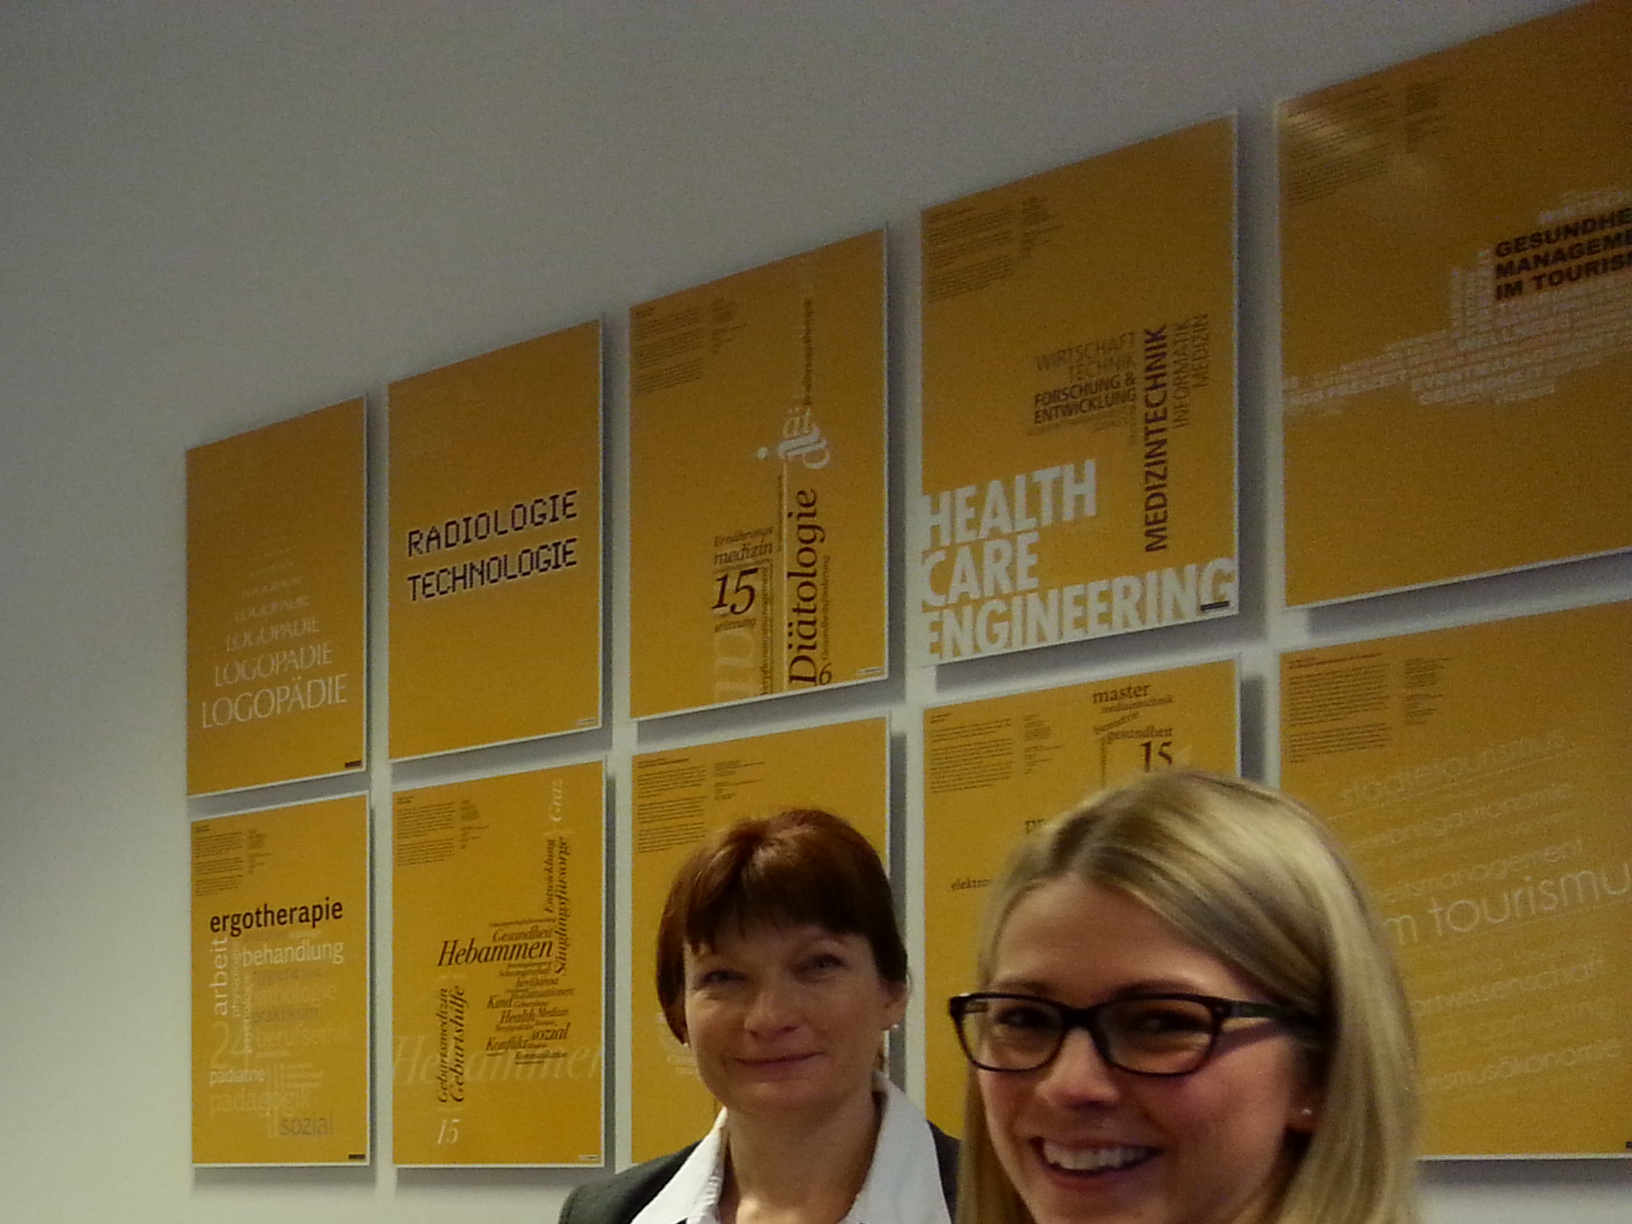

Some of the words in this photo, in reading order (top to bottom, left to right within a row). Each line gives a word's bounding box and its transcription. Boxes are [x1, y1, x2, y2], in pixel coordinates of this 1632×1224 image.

[1495, 276, 1525, 302] IM
[1033, 387, 1137, 426] ENTWICKLUNG
[1034, 372, 1121, 408] FORSCHUNG
[1144, 323, 1168, 553] MEDIZINTECHNIK
[407, 490, 579, 558] RADIOLOGIE
[922, 459, 1098, 549] HEALTH
[407, 538, 579, 602] TECHNOLOGIE
[711, 567, 759, 616] 15
[788, 488, 825, 688] Diätologie
[922, 531, 1040, 608] CARE
[924, 557, 1238, 664] ENGINEERING
[818, 663, 834, 686] 6
[1092, 683, 1151, 704] master
[201, 674, 349, 730] LOGOPÄDIE
[209, 896, 344, 938] ergotherapie
[241, 939, 345, 969] behandlung
[437, 938, 554, 968] Hebammen
[209, 936, 228, 1017] arbeit
[499, 1008, 536, 1025] Health
[531, 1021, 572, 1042] sozial
[448, 984, 470, 1104] Geburtshilfe
[436, 1117, 461, 1145] 15
